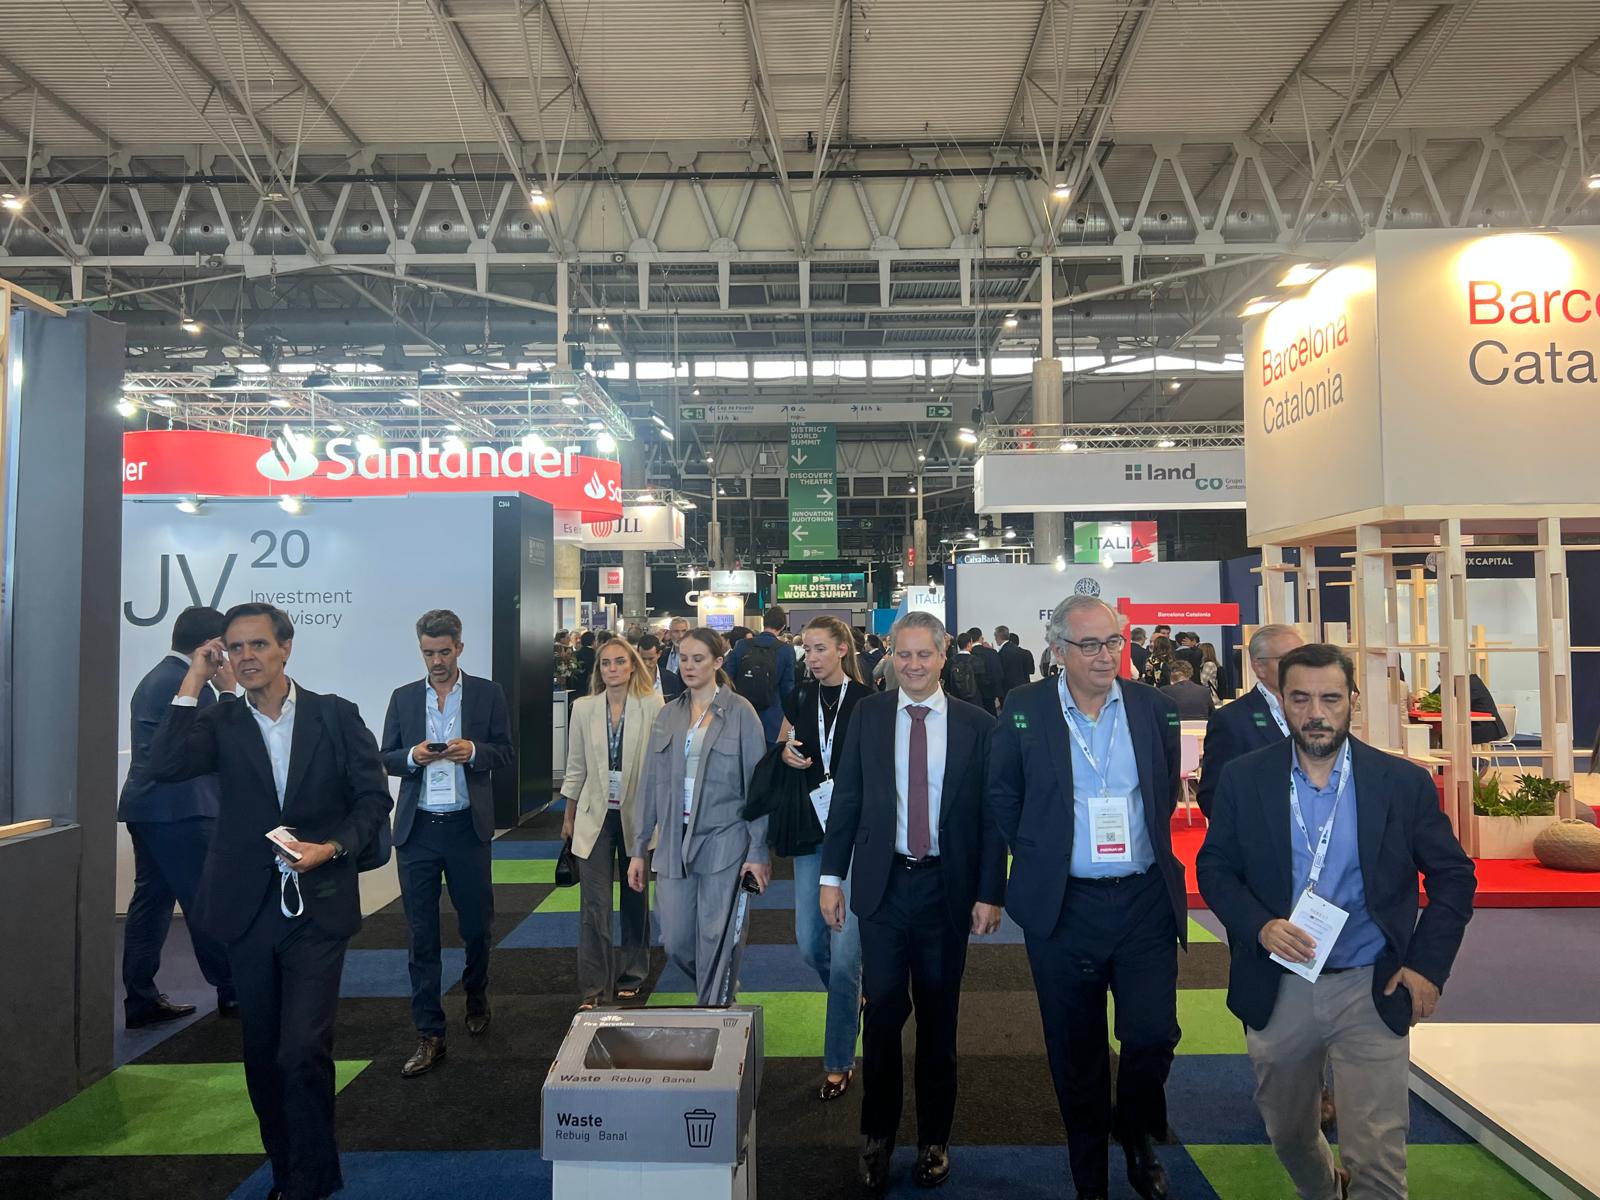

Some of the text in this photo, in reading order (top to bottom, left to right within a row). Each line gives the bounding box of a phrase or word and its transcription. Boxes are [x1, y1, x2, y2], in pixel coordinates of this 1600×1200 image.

[1468, 280, 1600, 326] Barc
[1262, 314, 1349, 387] Barcelona
[1262, 368, 1344, 434] Catalonia
[325, 436, 581, 481] Santander
[614, 518, 643, 534] JLL
[250, 529, 310, 569] 20
[1089, 536, 1144, 550] ITALIA
[964, 554, 1000, 564] CaixaBank
[1475, 558, 1514, 566] CAPITAL
[123, 553, 238, 627] JV
[250, 589, 353, 604] Investment
[916, 594, 946, 604] ITALIA
[288, 610, 343, 628] visory
[611, 1075, 652, 1084] Rebuig
[557, 1112, 603, 1127] Waste
[556, 1130, 628, 1142] Rebuig Banal
